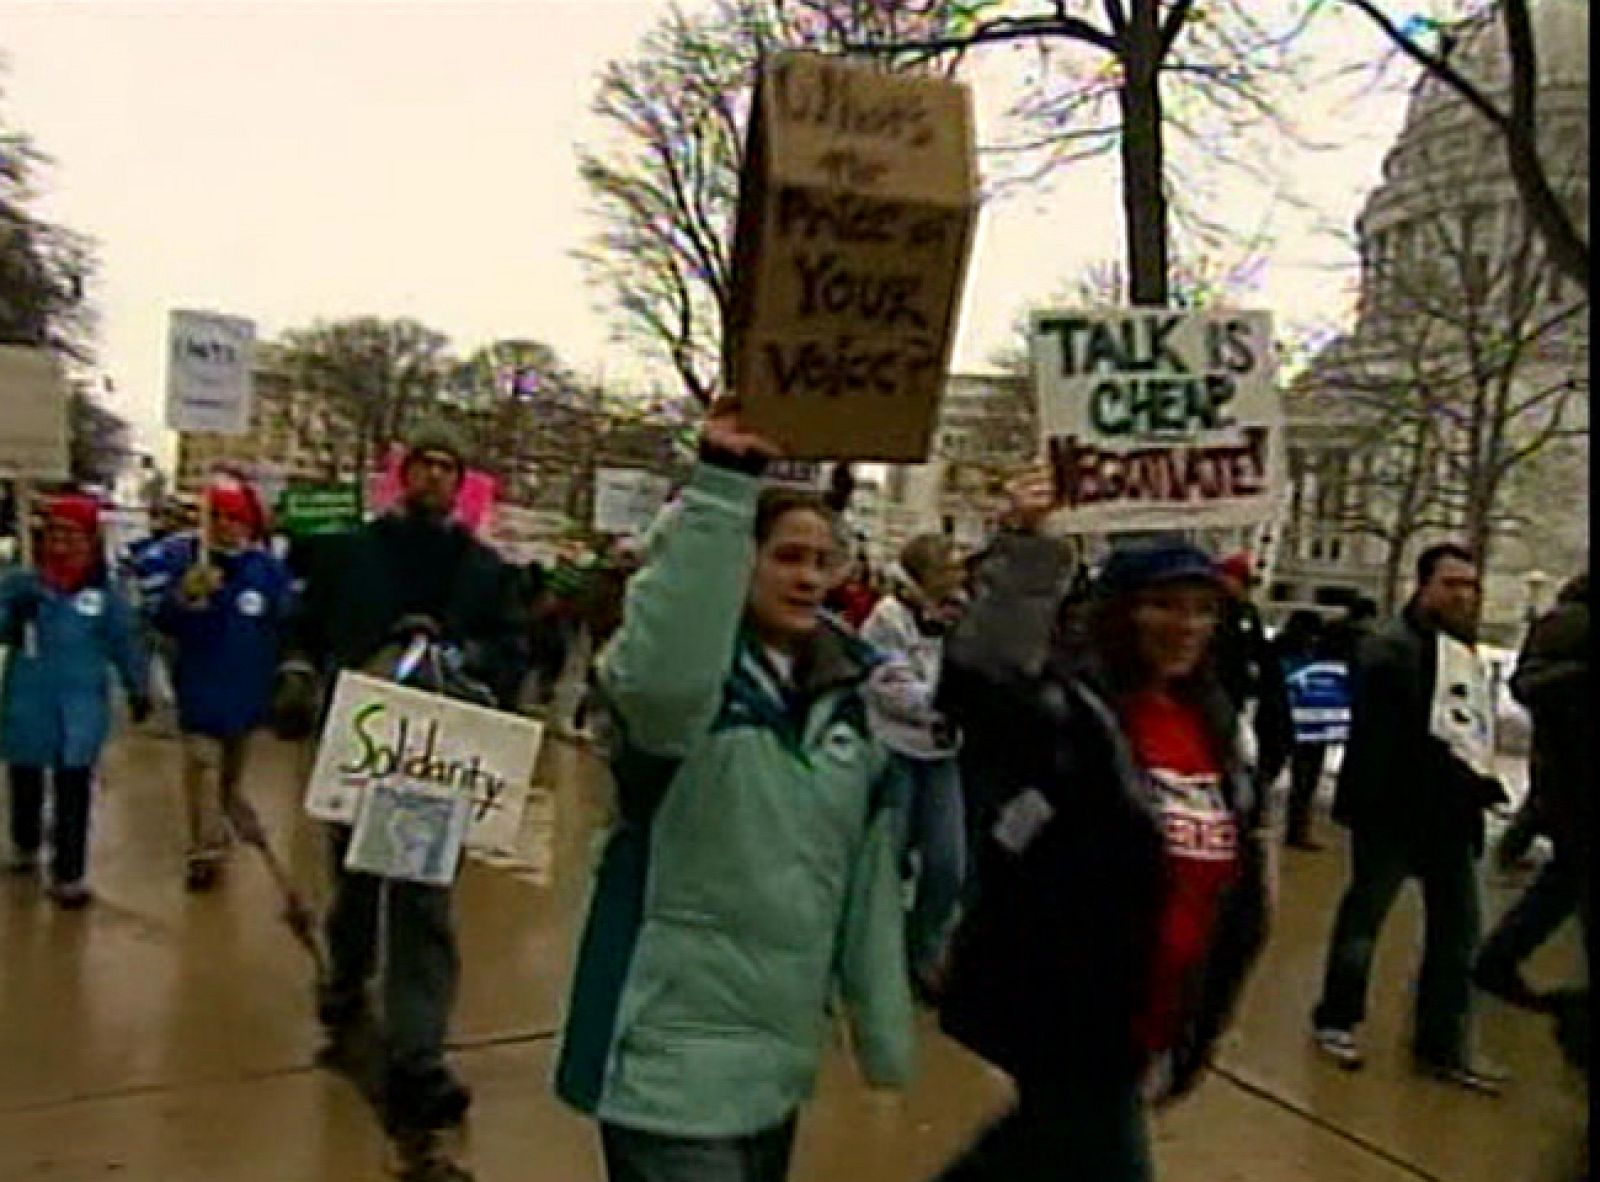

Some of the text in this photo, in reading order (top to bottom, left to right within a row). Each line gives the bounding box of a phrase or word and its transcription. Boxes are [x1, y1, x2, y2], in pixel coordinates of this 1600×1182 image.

[1040, 314, 1255, 378] TALK IS
[1088, 373, 1238, 434] CHEAP
[337, 702, 506, 823] Solidarity
